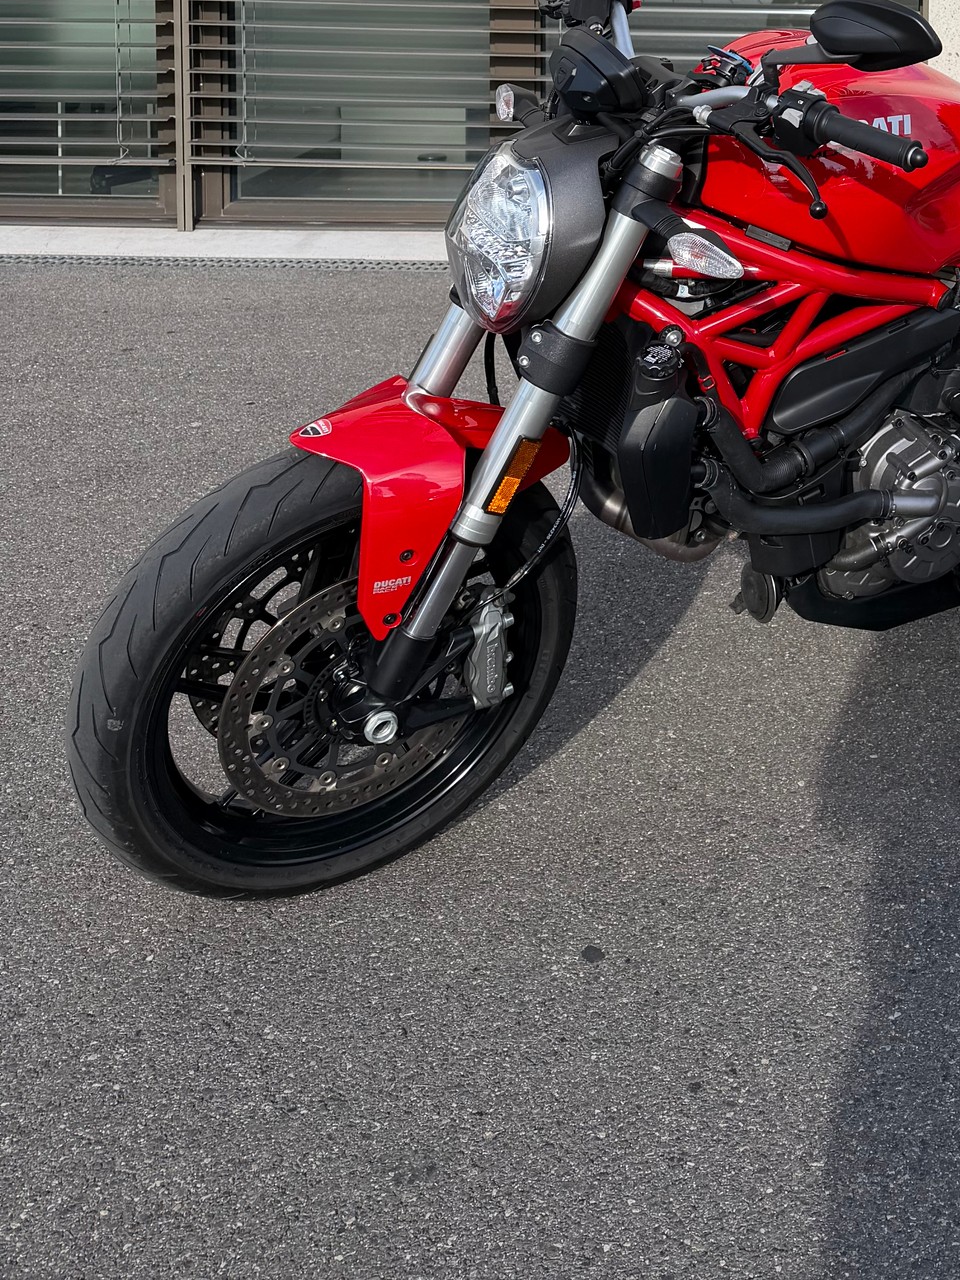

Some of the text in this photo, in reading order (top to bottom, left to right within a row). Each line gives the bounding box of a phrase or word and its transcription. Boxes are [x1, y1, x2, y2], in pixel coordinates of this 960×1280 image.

[857, 114, 911, 136] ATI
[373, 576, 411, 589] DUCATI
[486, 642, 499, 693] brembo
